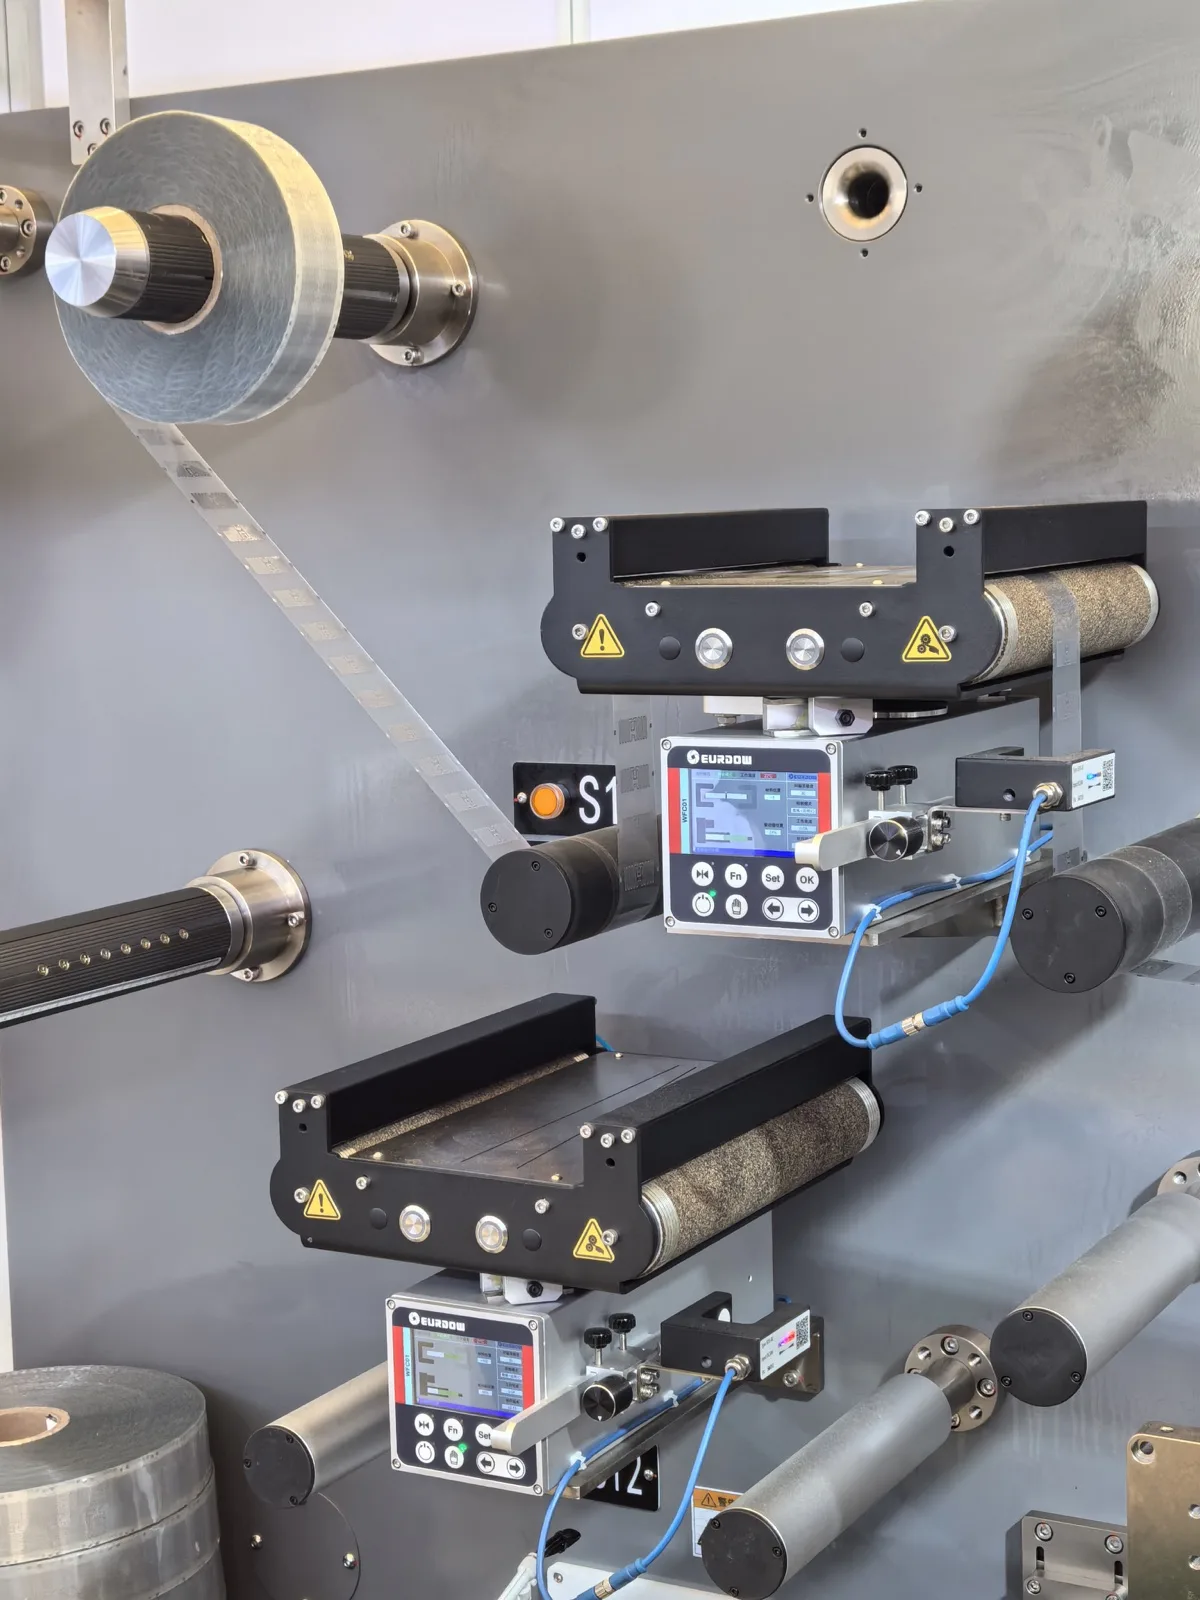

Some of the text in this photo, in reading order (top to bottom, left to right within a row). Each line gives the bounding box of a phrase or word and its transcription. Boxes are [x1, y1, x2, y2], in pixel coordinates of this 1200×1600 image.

[700, 754, 753, 765] EURDOW
[730, 871, 742, 881] Fn
[765, 873, 780, 883] Set
[799, 875, 815, 885] OK
[421, 1316, 466, 1332] EURDOW
[447, 1425, 458, 1435] Fn
[478, 1430, 491, 1440] Set
